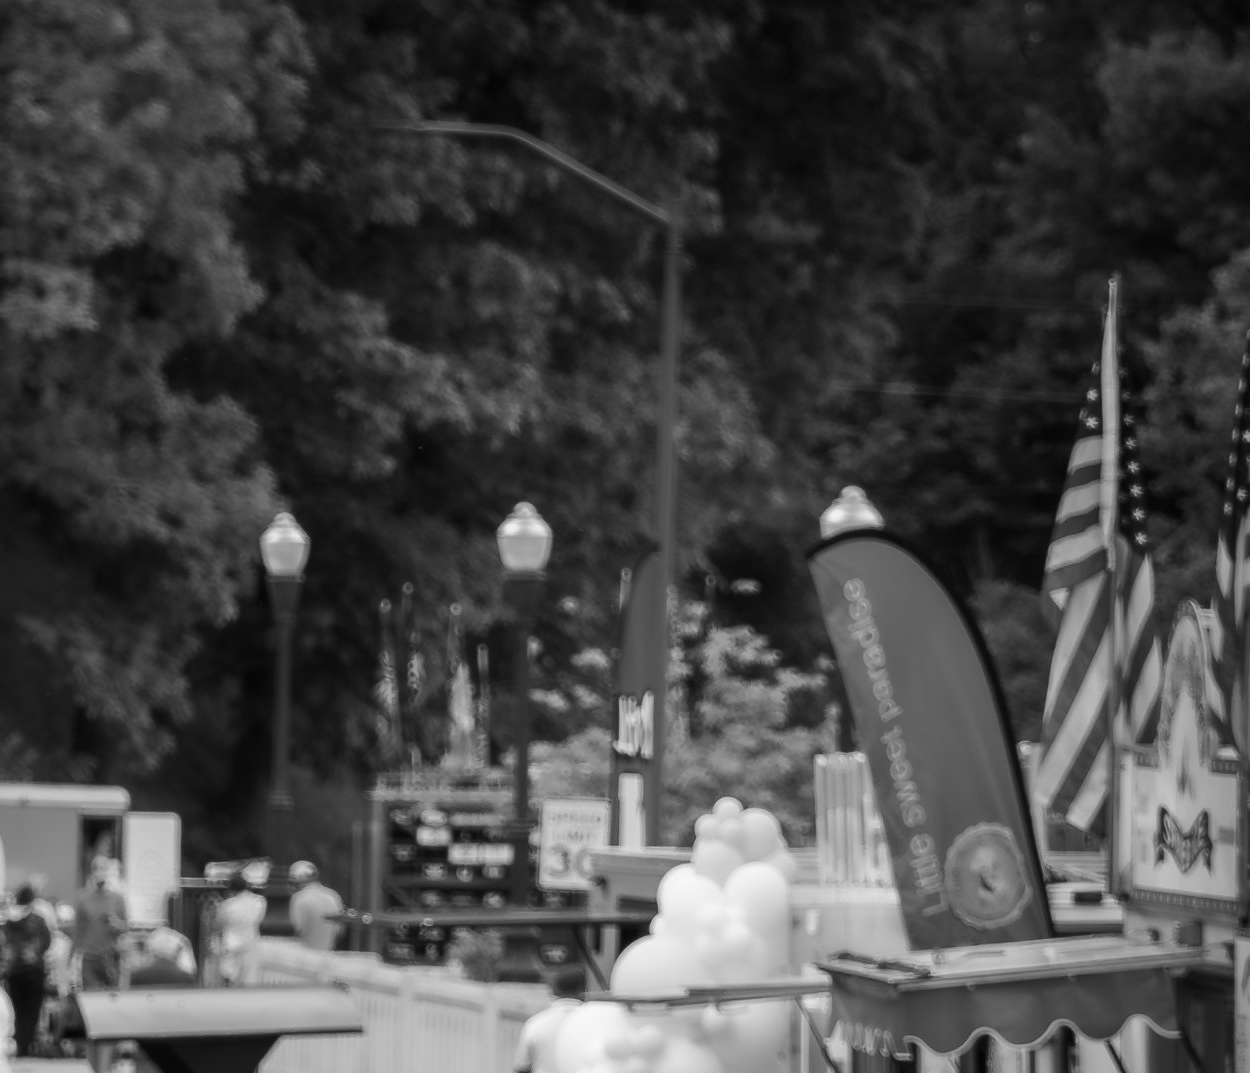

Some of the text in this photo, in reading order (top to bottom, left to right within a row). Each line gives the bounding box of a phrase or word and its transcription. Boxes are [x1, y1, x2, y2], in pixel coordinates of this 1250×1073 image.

[844, 578, 949, 916] Little sweet paradise
